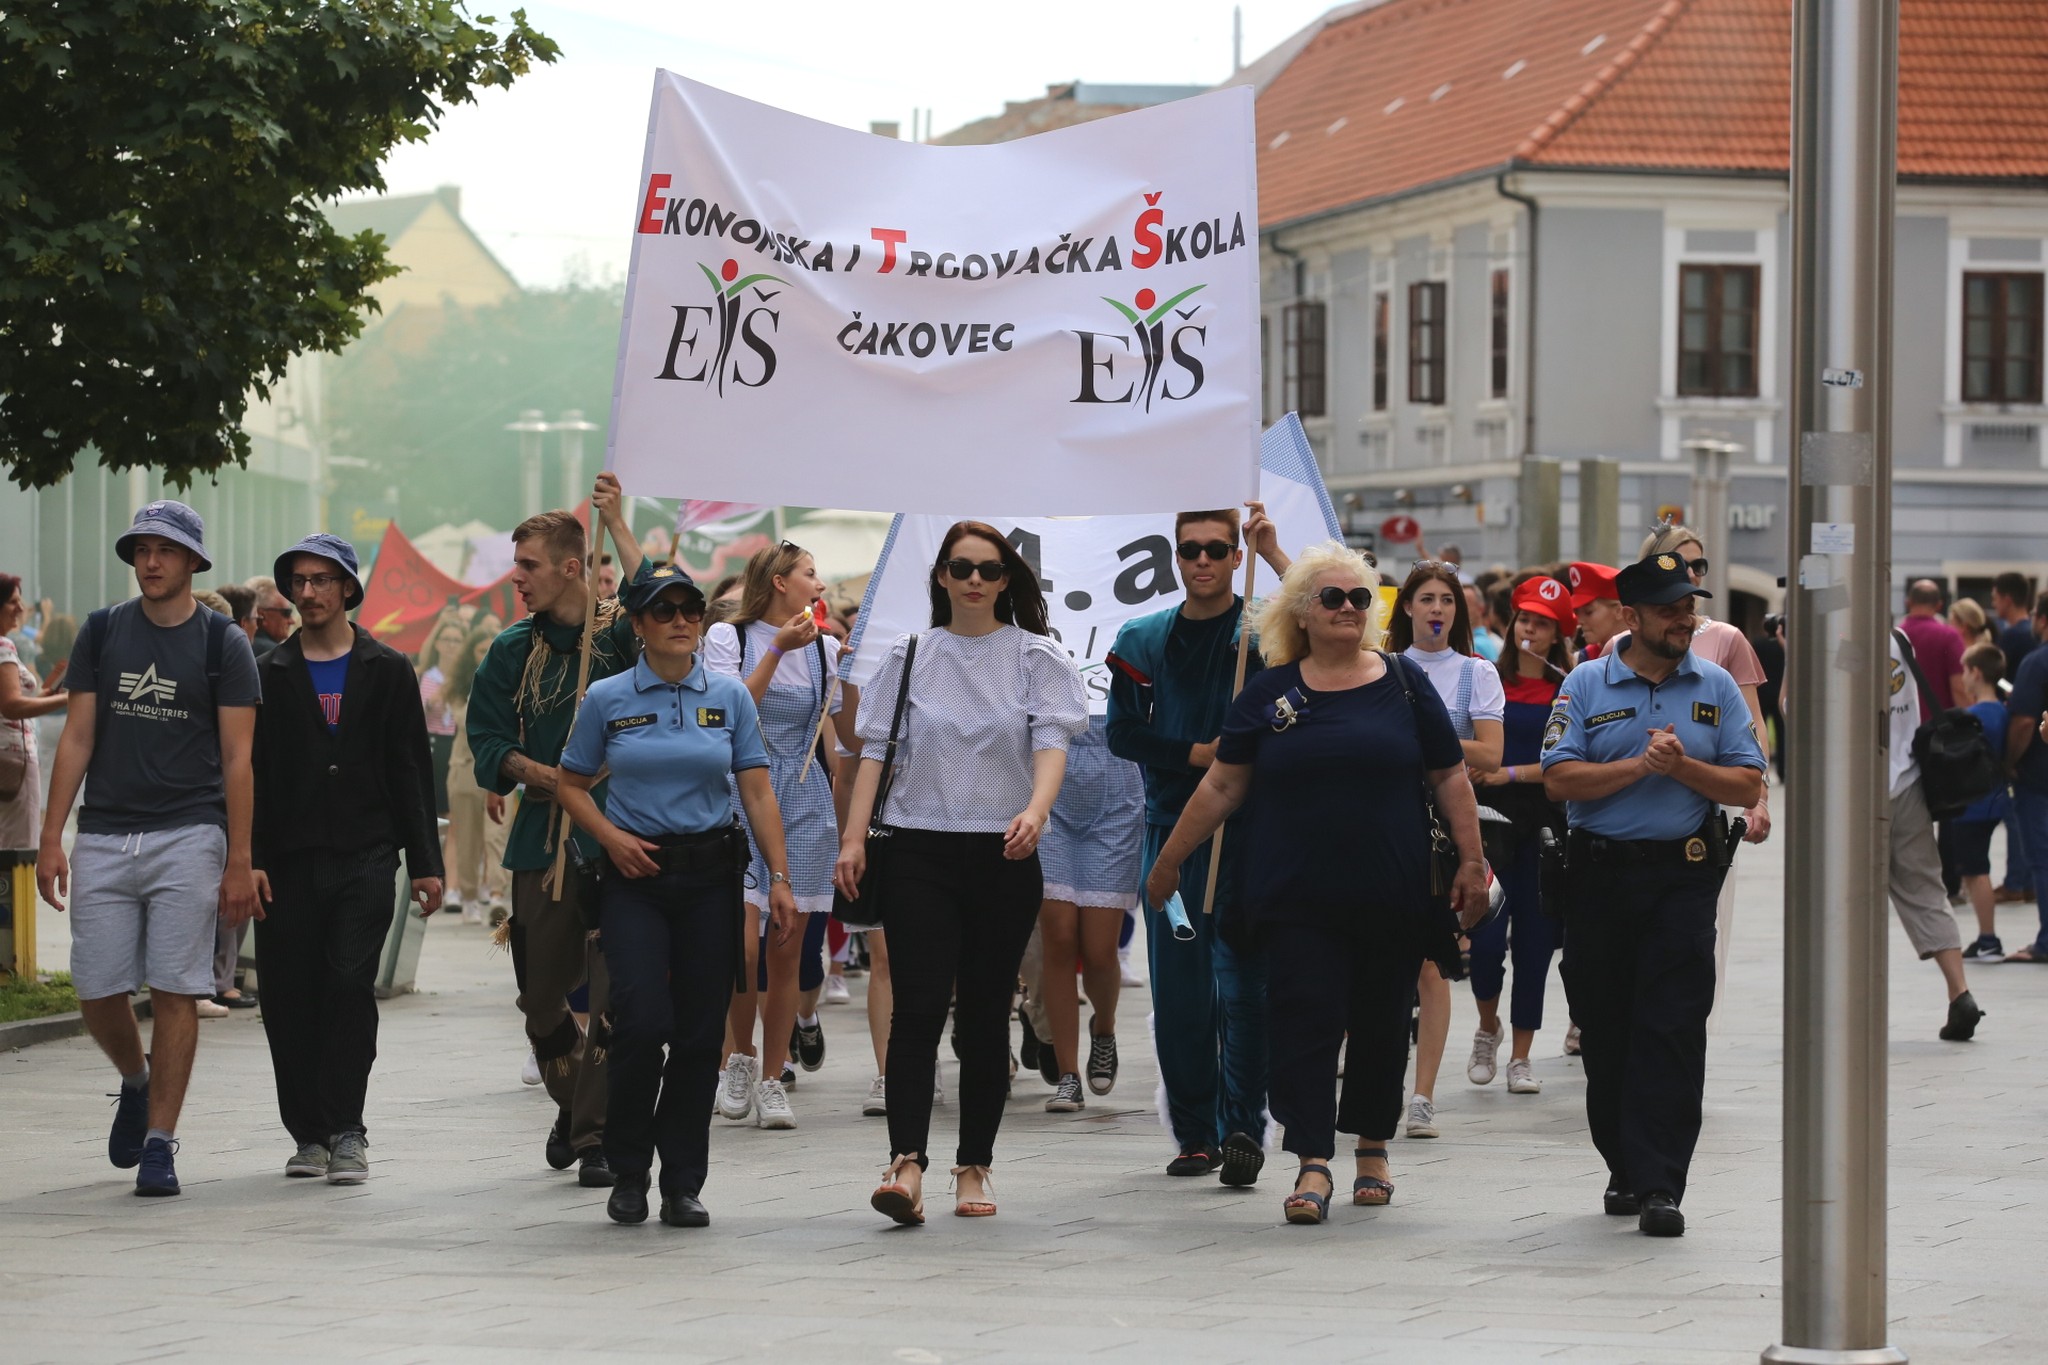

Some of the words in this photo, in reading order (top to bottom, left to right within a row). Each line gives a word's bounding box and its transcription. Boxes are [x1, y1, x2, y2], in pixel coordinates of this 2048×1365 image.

[638, 174, 832, 272] EKONOMSKA
[871, 227, 1123, 281] TRGOVAČKA
[1131, 191, 1246, 270] ŠKOLA
[837, 311, 1016, 359] ČAKOVEC
[615, 717, 647, 727] POLICIJA
[1591, 710, 1627, 724] POLICIJA
